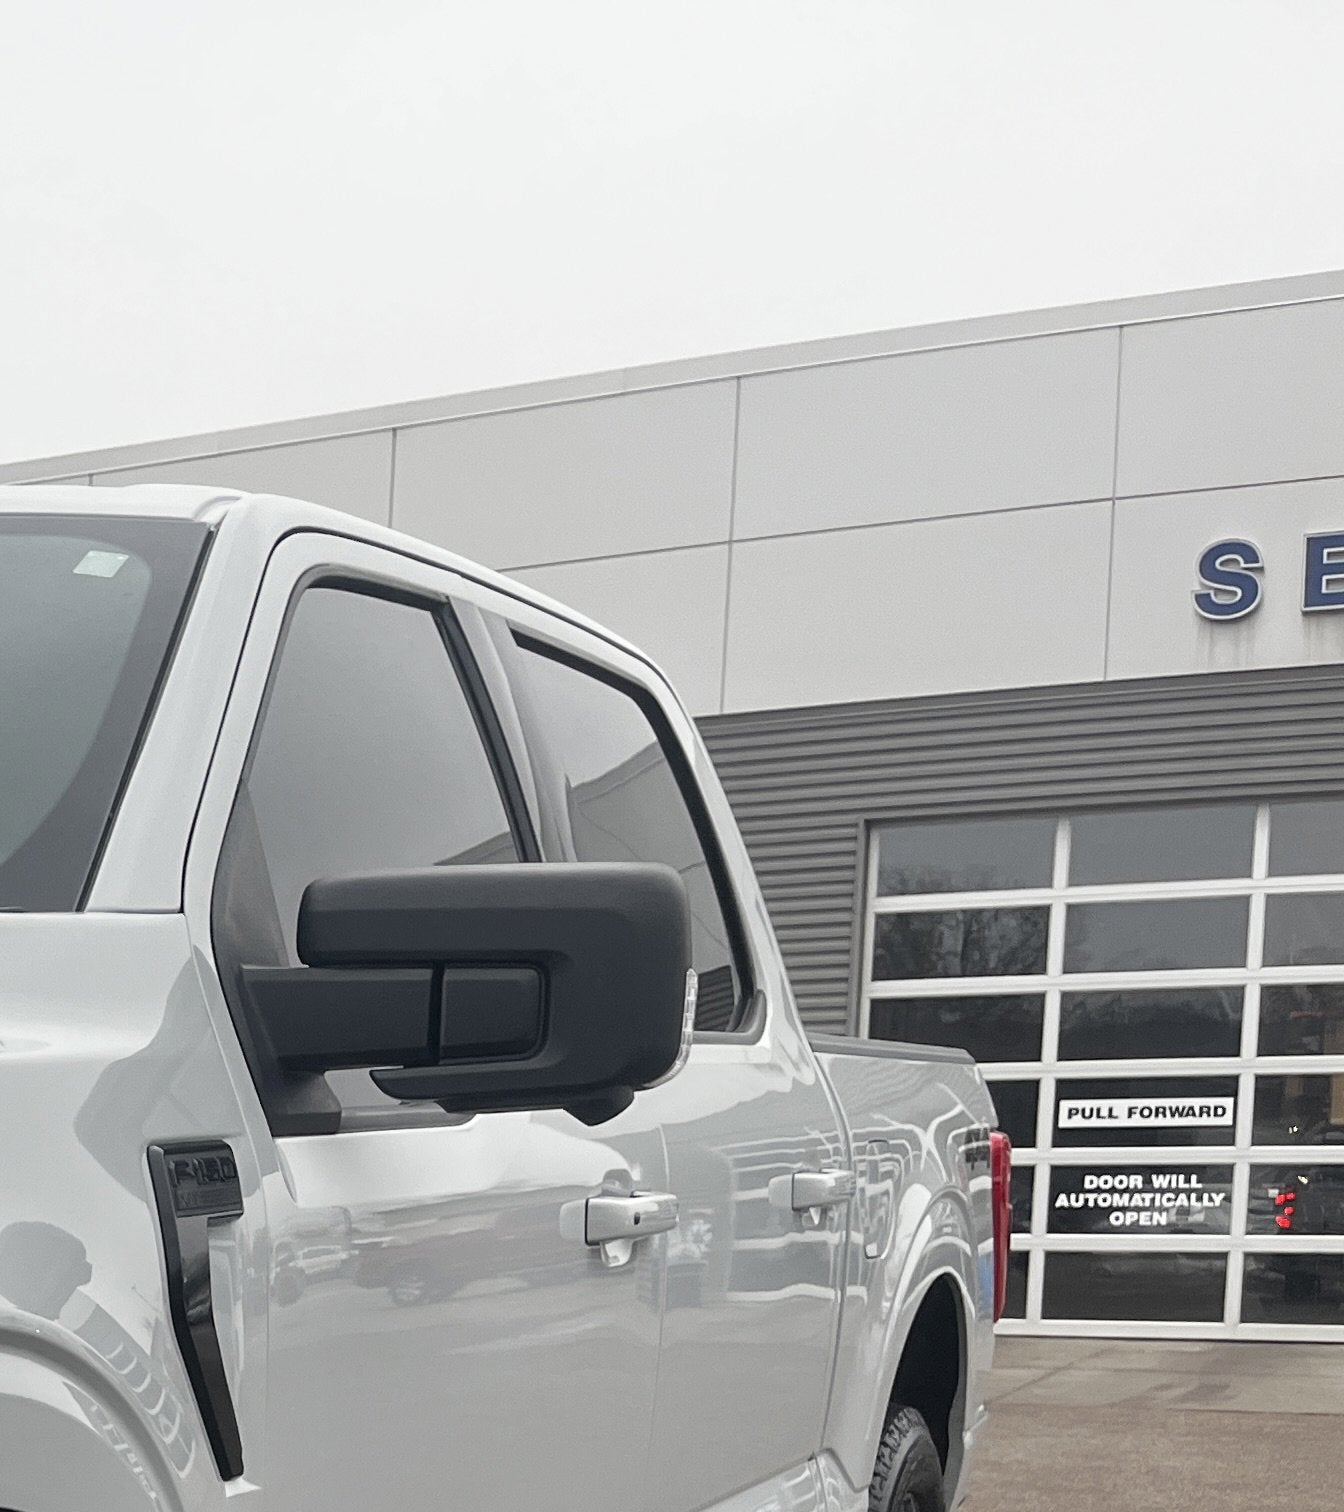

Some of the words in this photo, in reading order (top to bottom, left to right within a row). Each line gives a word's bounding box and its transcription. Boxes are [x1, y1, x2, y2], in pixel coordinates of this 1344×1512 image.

[1067, 1106, 1119, 1120] PULL
[1127, 1105, 1227, 1119] FORWARD
[1083, 1174, 1143, 1190] DOOR
[1151, 1174, 1203, 1189] WILL
[1054, 1192, 1226, 1208] AUTOMATICALLY
[1109, 1211, 1168, 1226] OPEN
